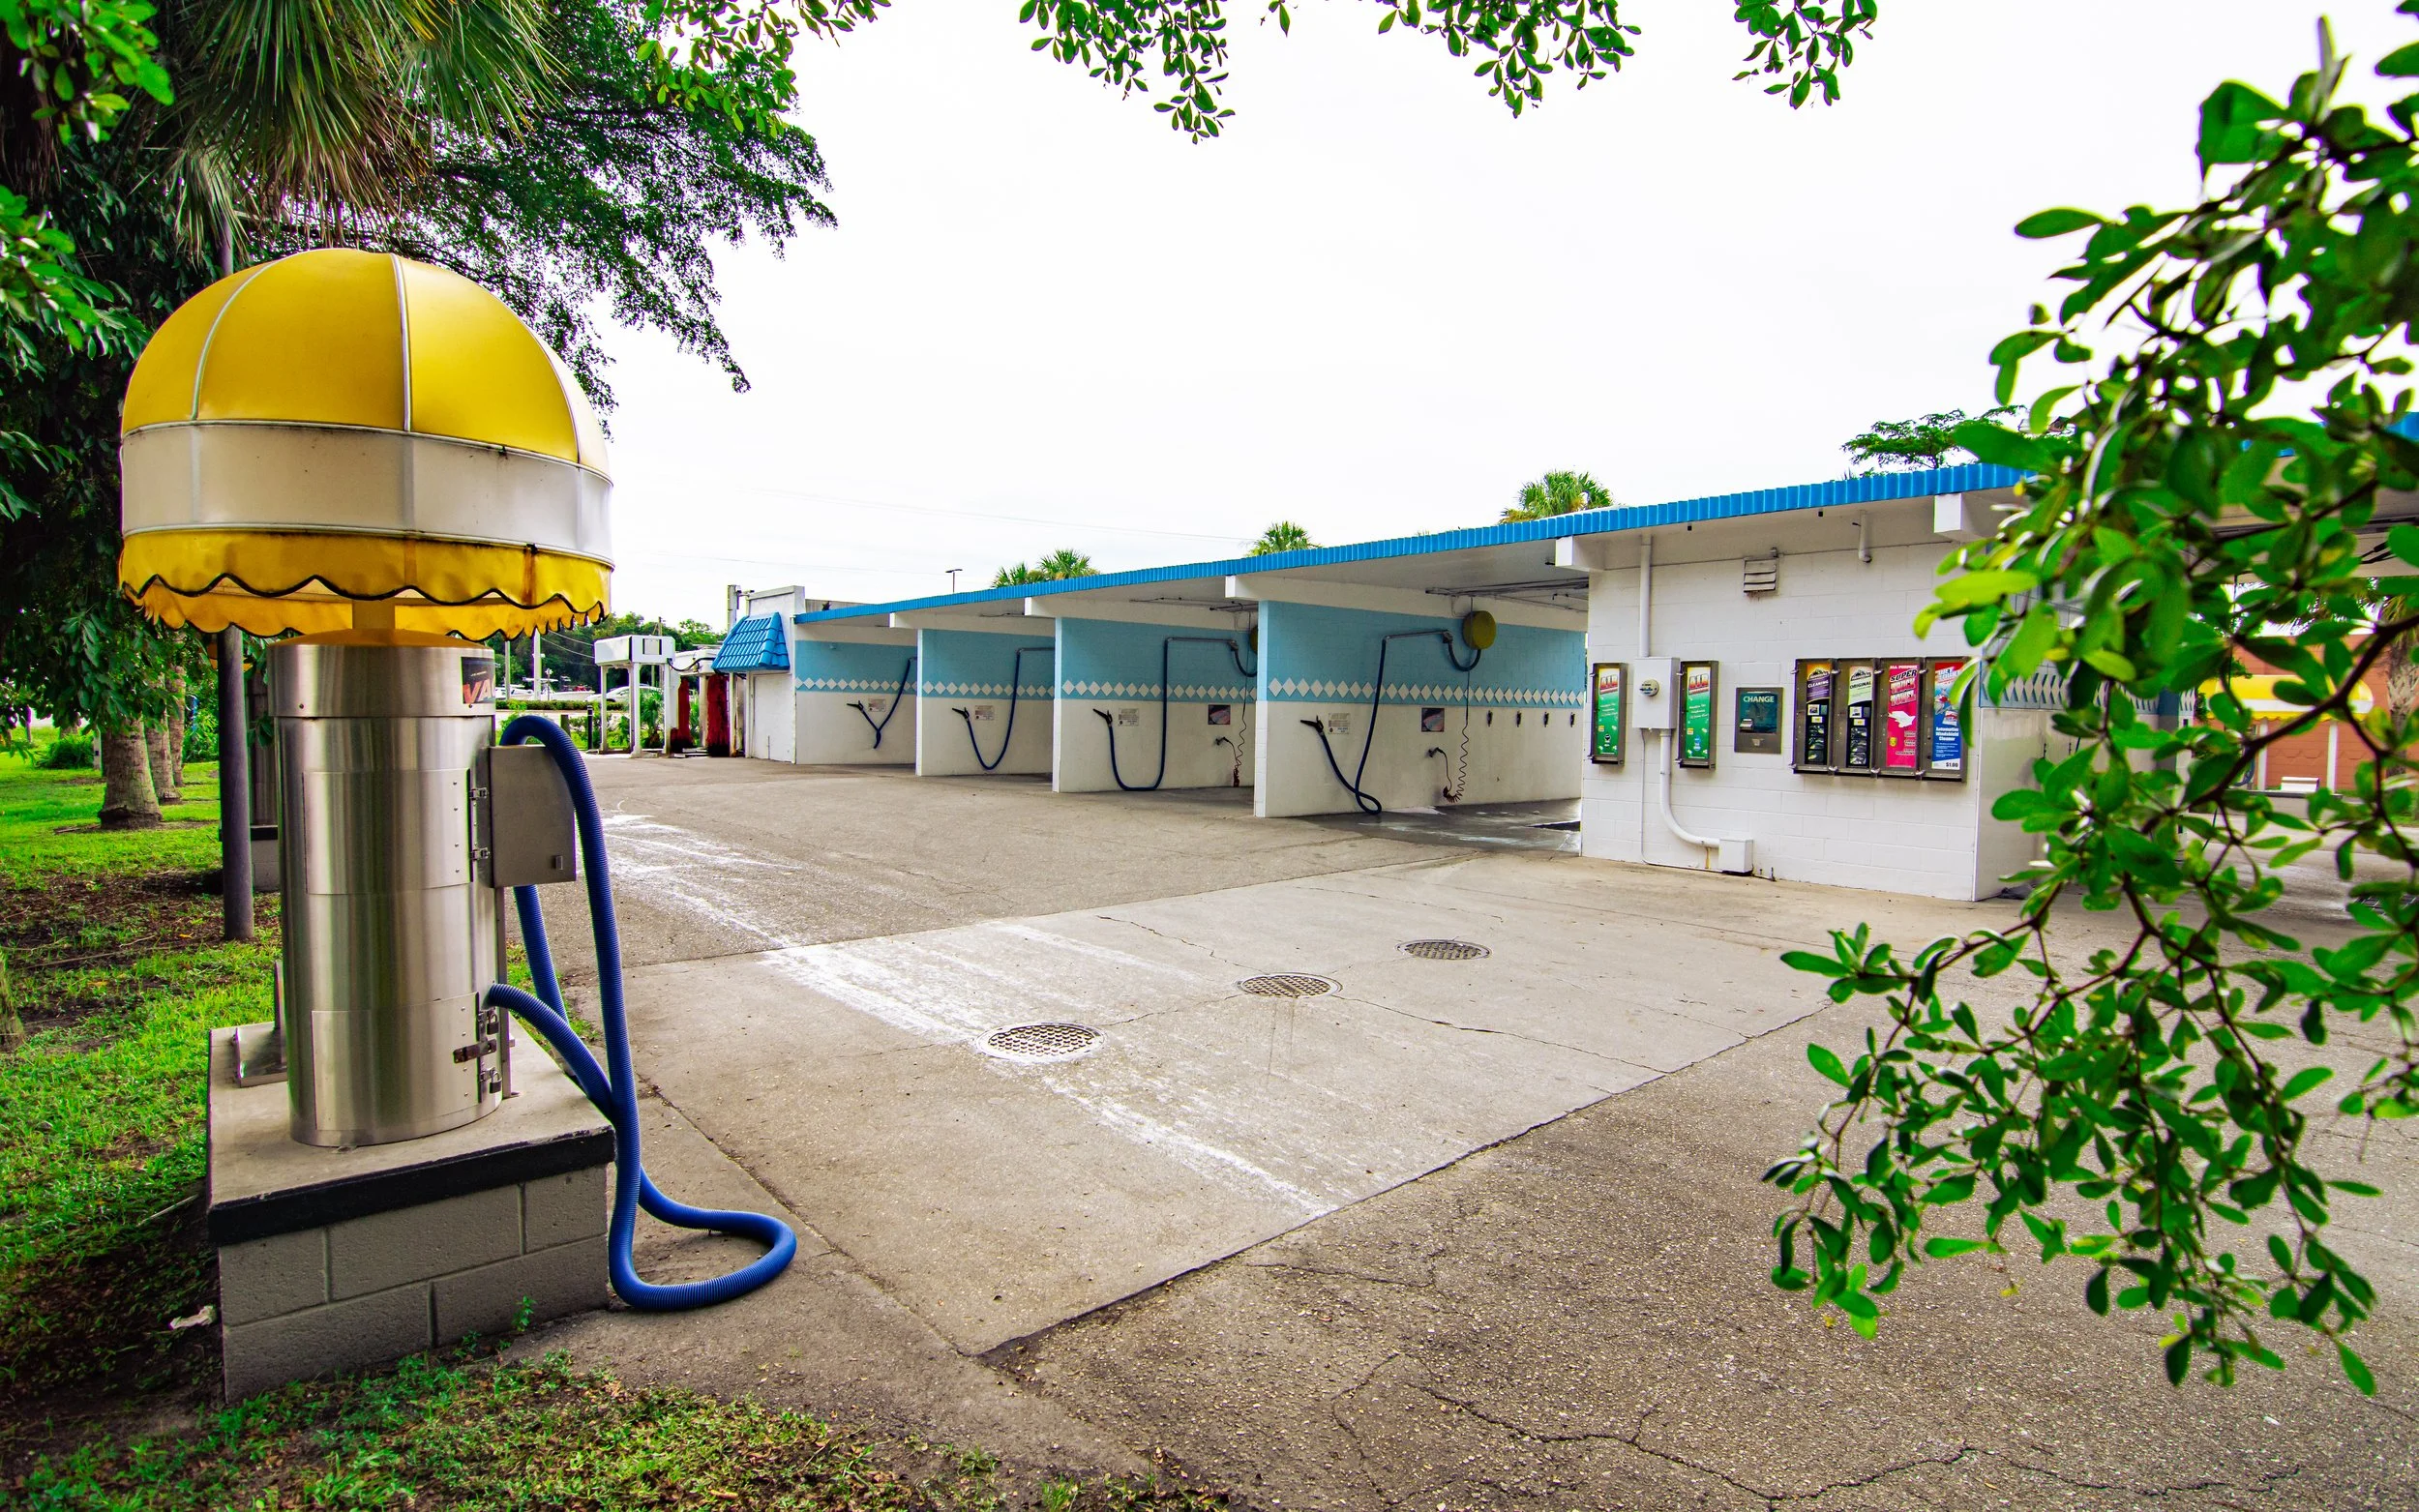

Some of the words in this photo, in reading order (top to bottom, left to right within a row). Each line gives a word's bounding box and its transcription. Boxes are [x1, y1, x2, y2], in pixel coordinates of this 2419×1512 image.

[1890, 669, 1918, 682] SUPER
[463, 678, 495, 703] VA
[1849, 680, 1871, 690] ORIGINAL
